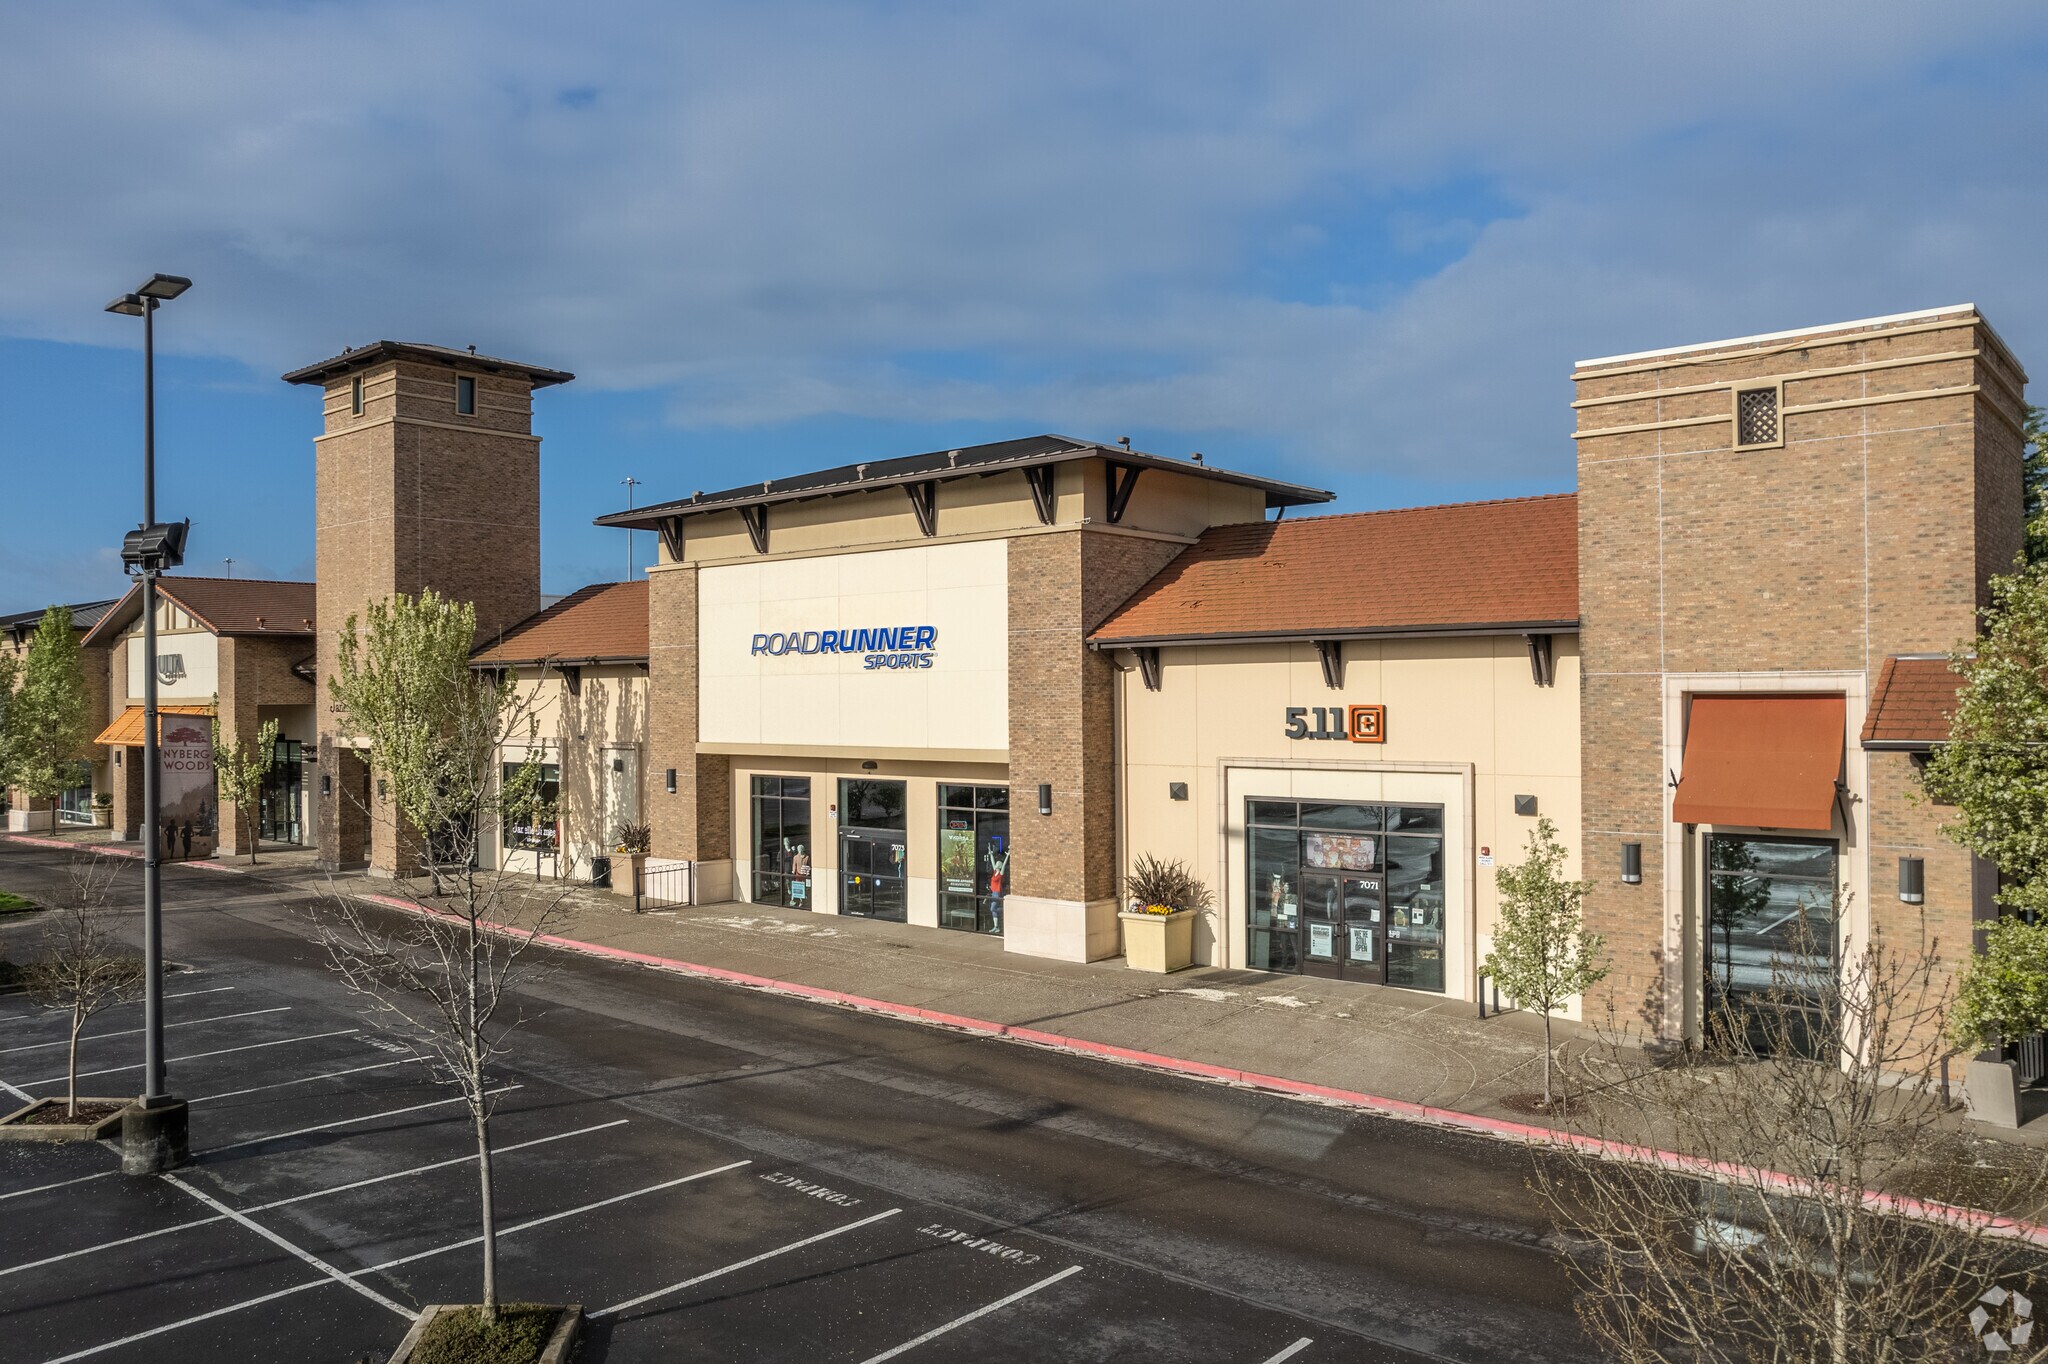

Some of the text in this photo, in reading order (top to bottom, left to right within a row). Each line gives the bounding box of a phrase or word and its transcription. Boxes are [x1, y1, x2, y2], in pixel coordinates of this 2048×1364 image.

[864, 652, 934, 670] SPORTS
[1284, 706, 1348, 741] 5.11
[163, 749, 210, 759] NYBERG
[163, 760, 210, 771] WOODS
[1360, 880, 1379, 890] 7071
[1355, 944, 1368, 952] OPEN
[759, 1171, 863, 1207] COMPACT
[915, 1223, 1040, 1265] COMPACT
